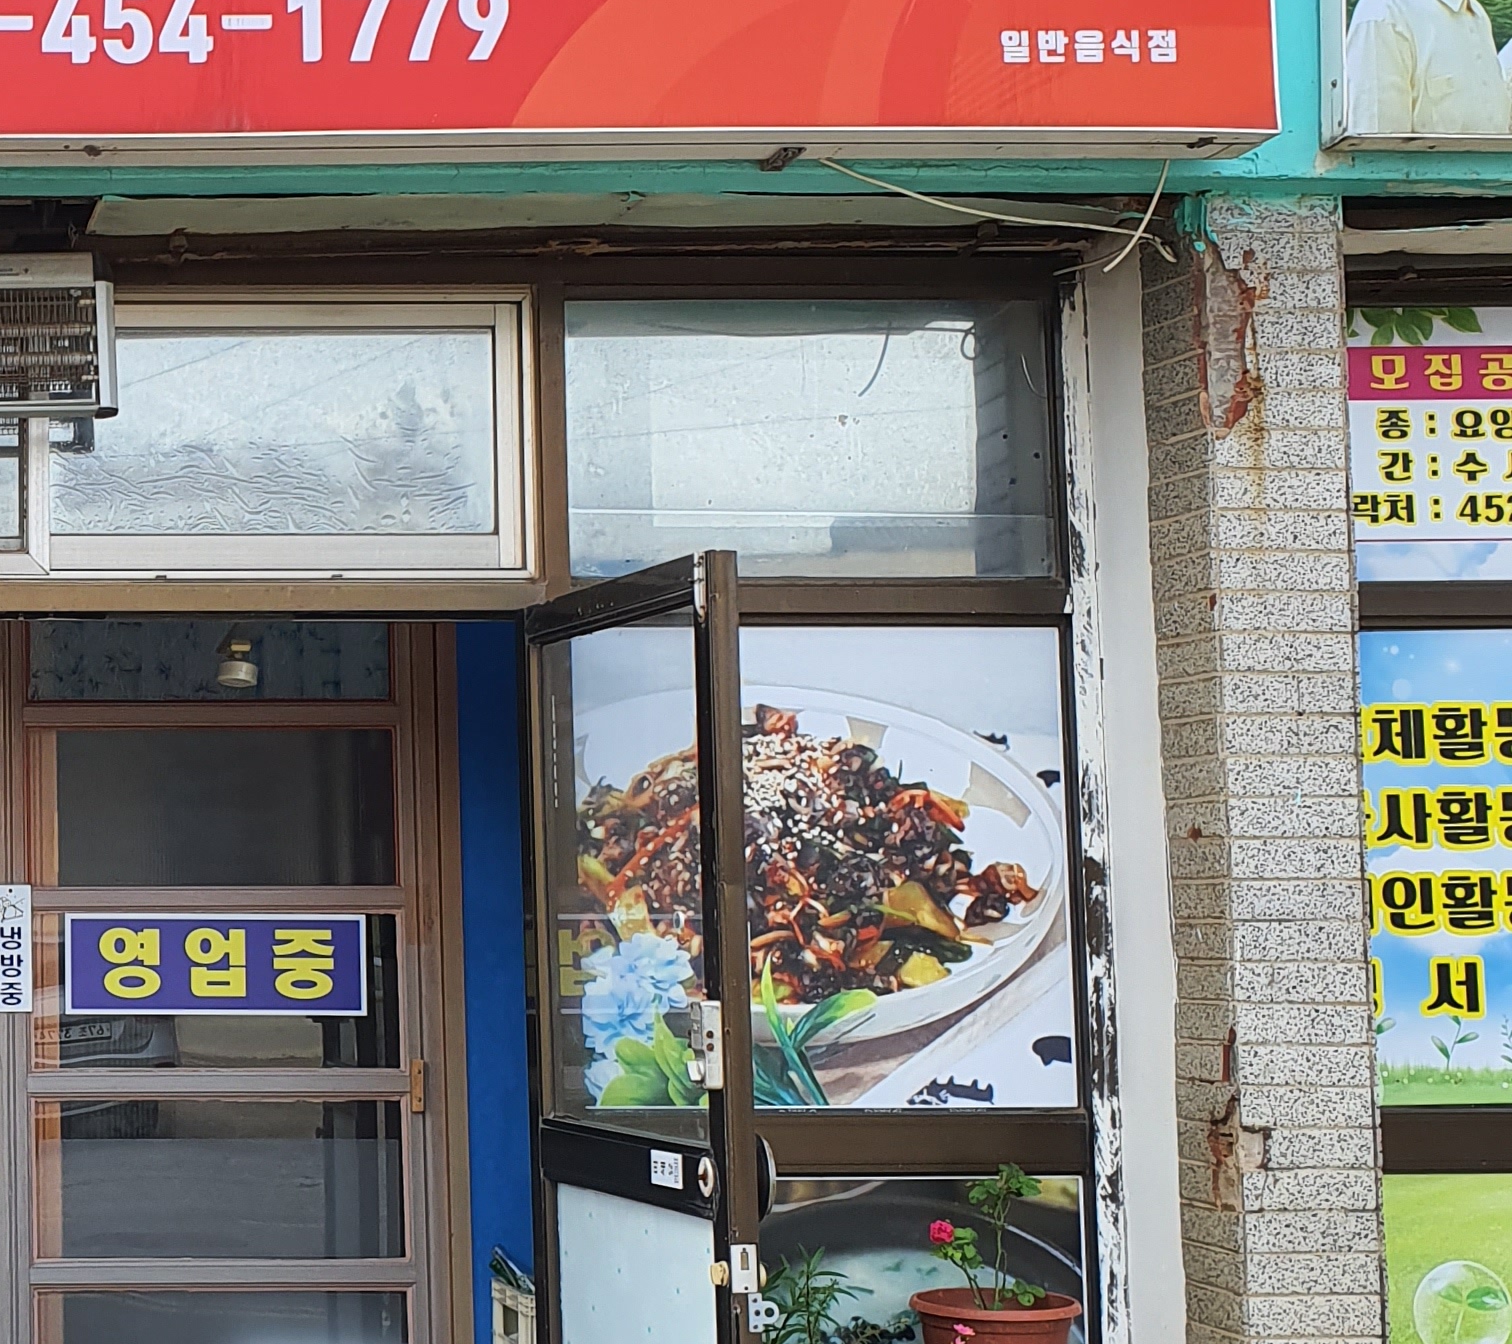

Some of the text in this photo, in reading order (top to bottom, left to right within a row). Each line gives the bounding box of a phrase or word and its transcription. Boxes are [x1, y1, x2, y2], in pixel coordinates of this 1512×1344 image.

[1000, 29, 1177, 63] 일반음식점
[1361, 707, 1512, 760] 체활
[1364, 792, 1512, 844] 사활
[1368, 876, 1512, 930] 인활
[0, 926, 24, 1006] 냉방중
[97, 926, 336, 1001] 영업중
